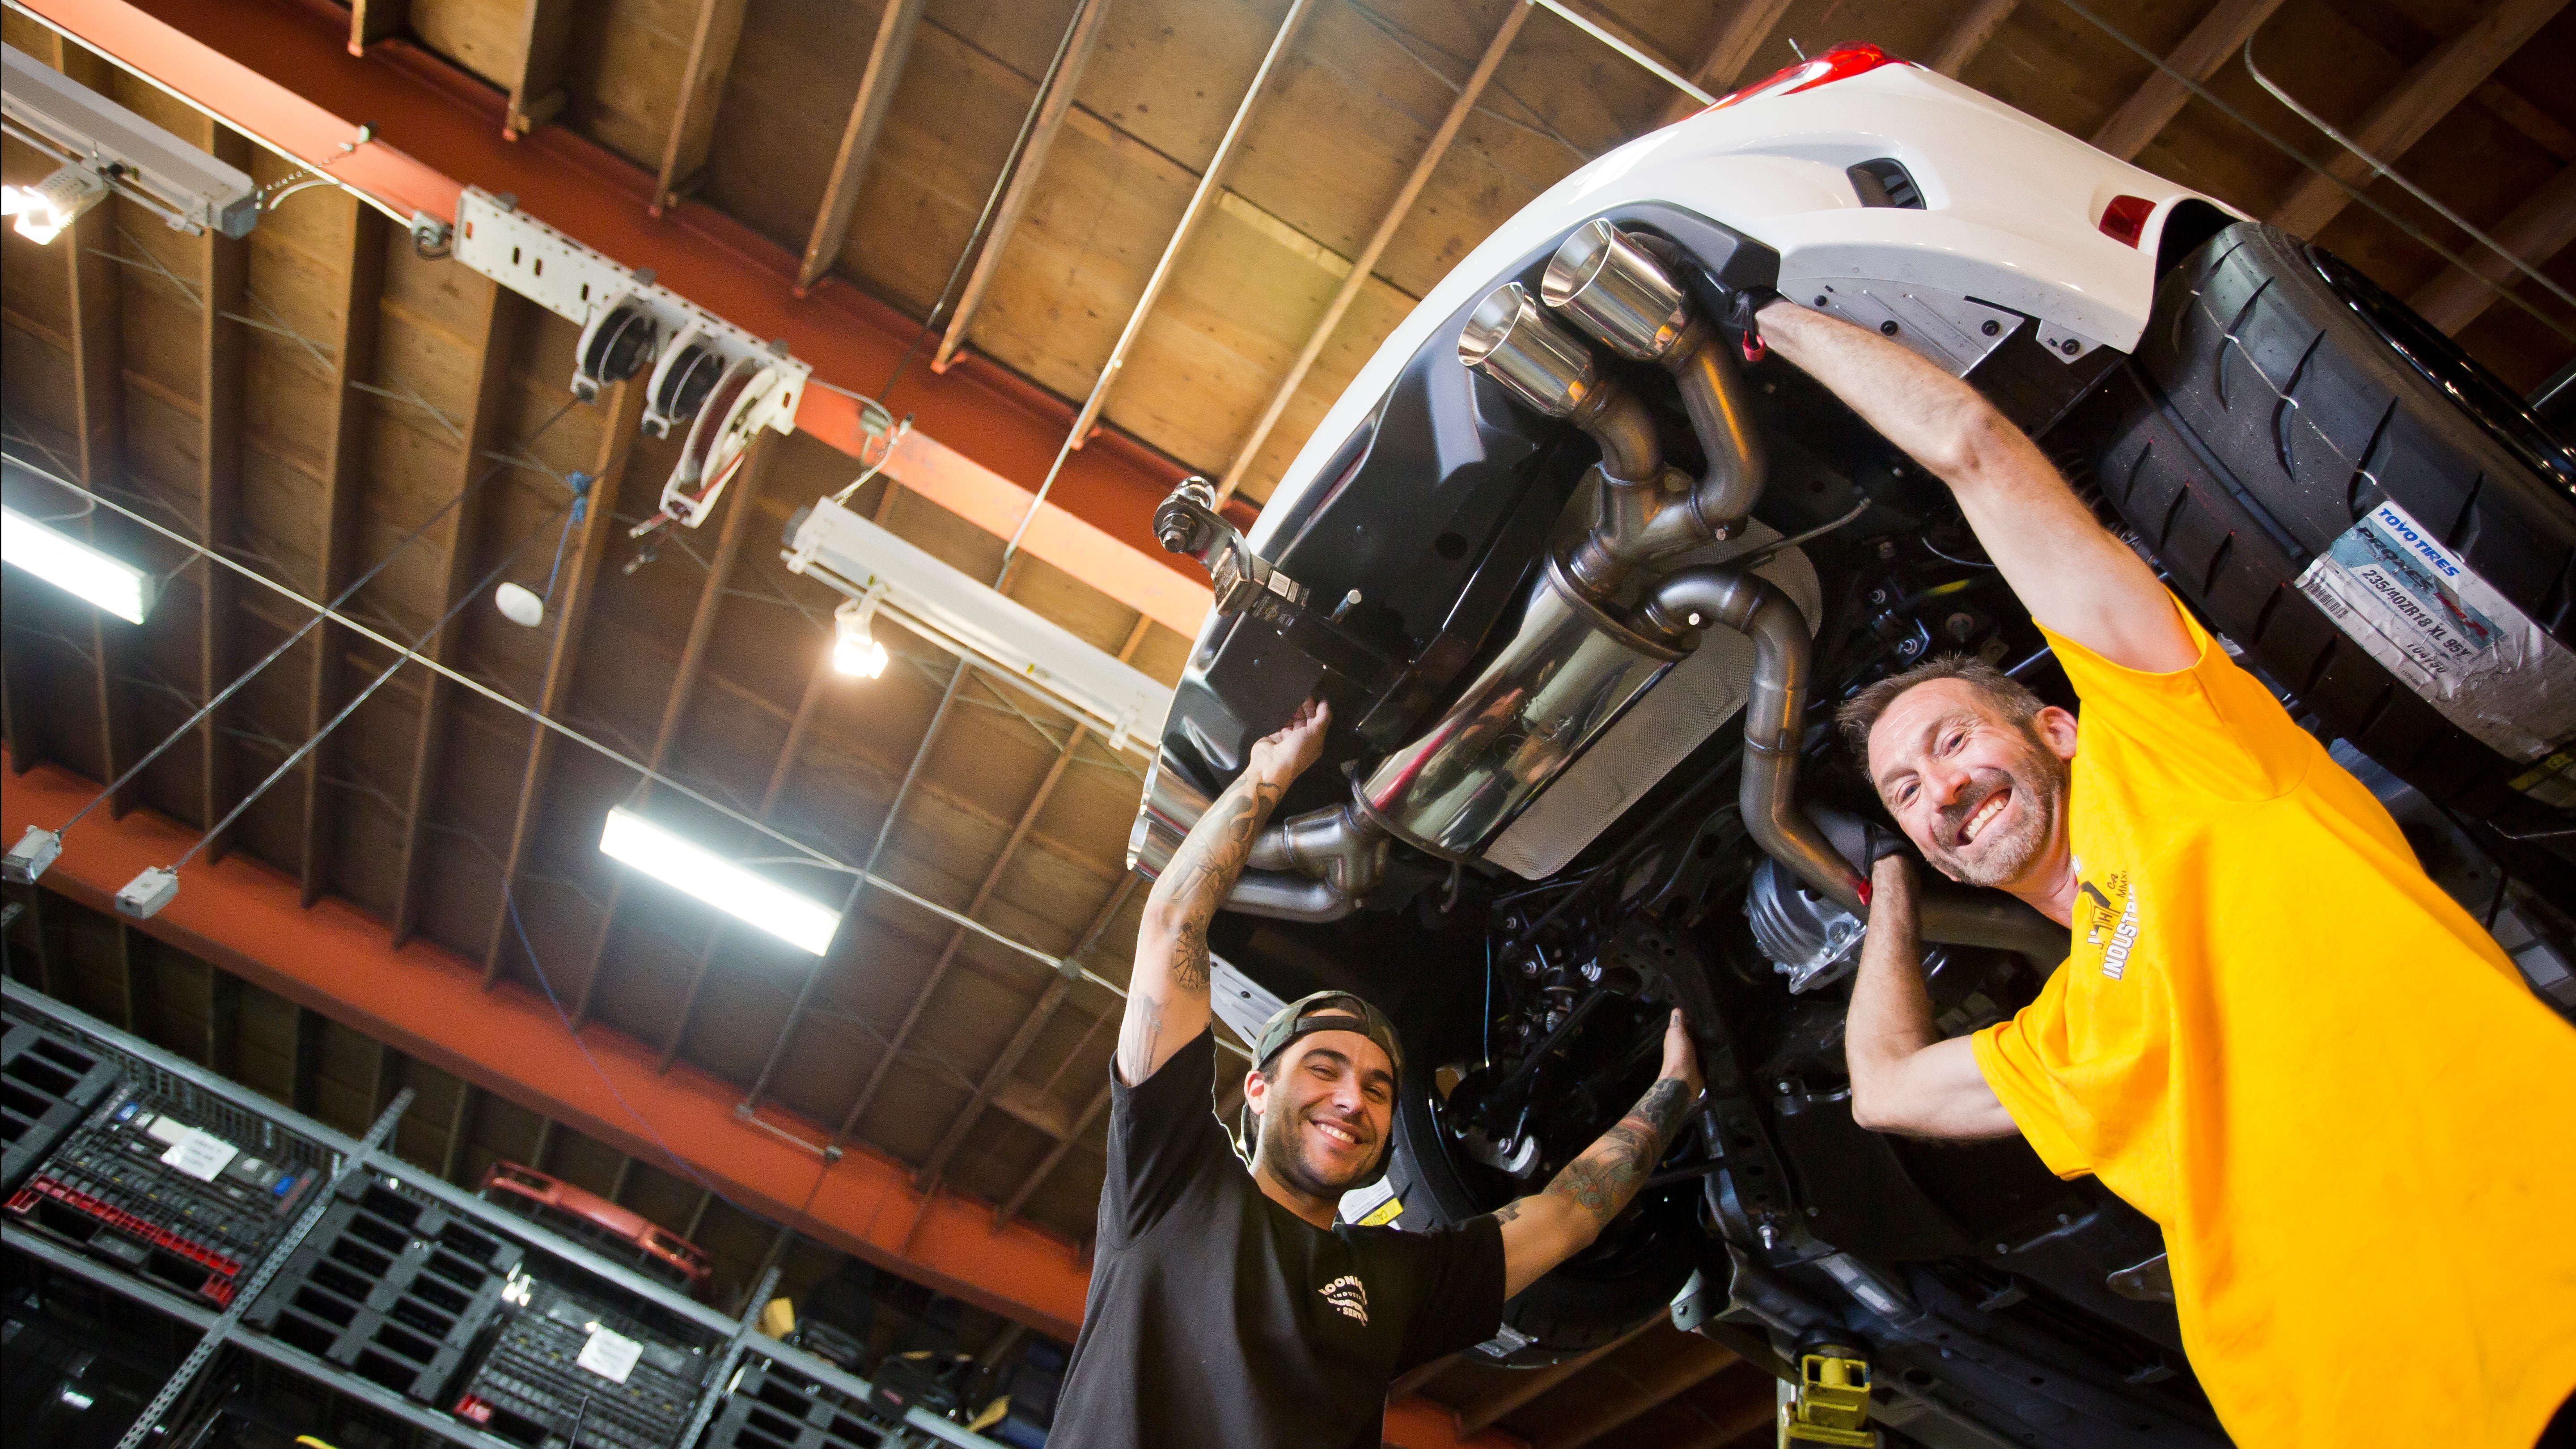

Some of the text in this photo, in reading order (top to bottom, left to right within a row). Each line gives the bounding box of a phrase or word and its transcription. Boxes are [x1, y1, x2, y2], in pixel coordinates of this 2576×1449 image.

[2377, 508, 2460, 577] TOYO TIRES
[2362, 569, 2433, 627] 235/40ZR18
[2428, 625, 2447, 641] XL
[2442, 639, 2472, 657] 95Y
[2097, 912, 2113, 923] H
[2115, 870, 2127, 898] MMXI
[2102, 883, 2138, 980] INDUSTR
